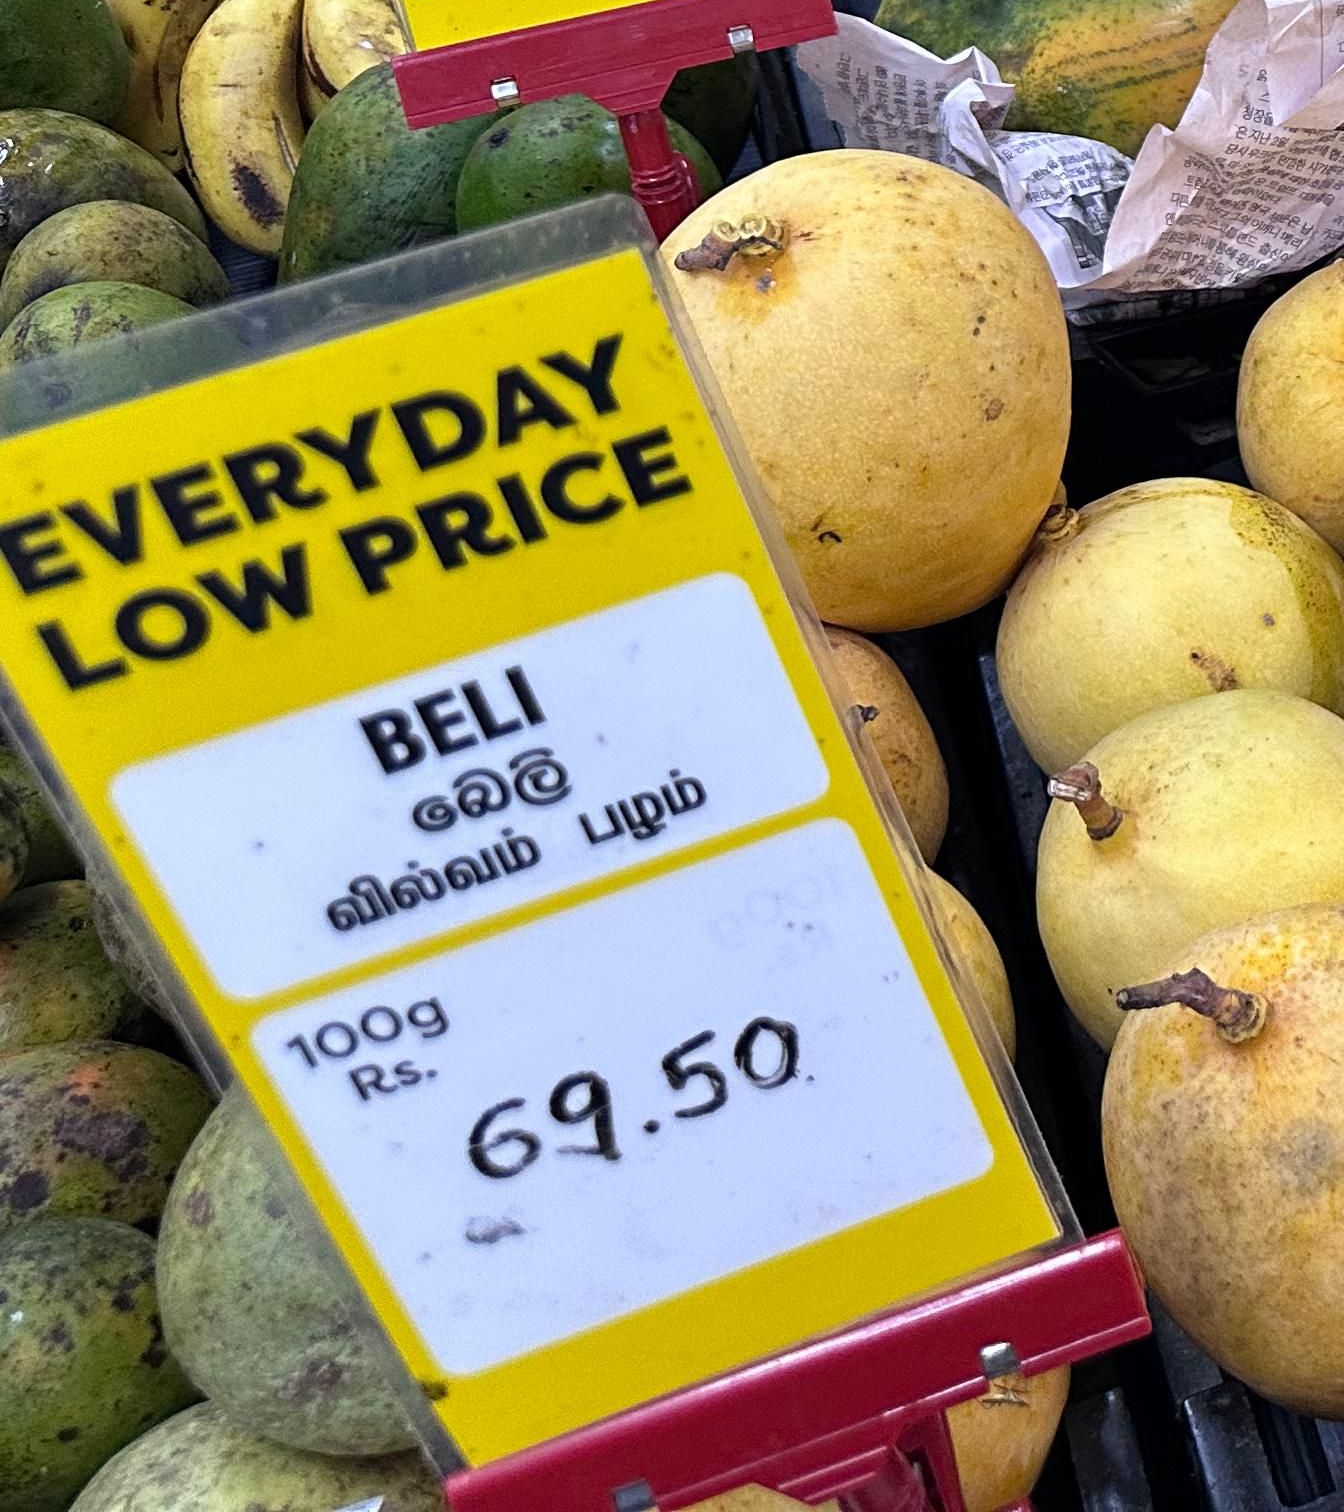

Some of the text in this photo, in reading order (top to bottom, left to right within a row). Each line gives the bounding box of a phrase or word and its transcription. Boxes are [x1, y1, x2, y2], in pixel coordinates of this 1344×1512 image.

[0, 334, 625, 596] EVERYDAY
[35, 426, 693, 691] LOW PRICE
[358, 666, 547, 775] BELI
[325, 768, 707, 932] வில்வம் பழம்
[411, 747, 573, 834] බෙලි
[285, 993, 451, 1070] 100g
[349, 1058, 439, 1102] Rs.
[466, 1015, 801, 1178] 69.50
